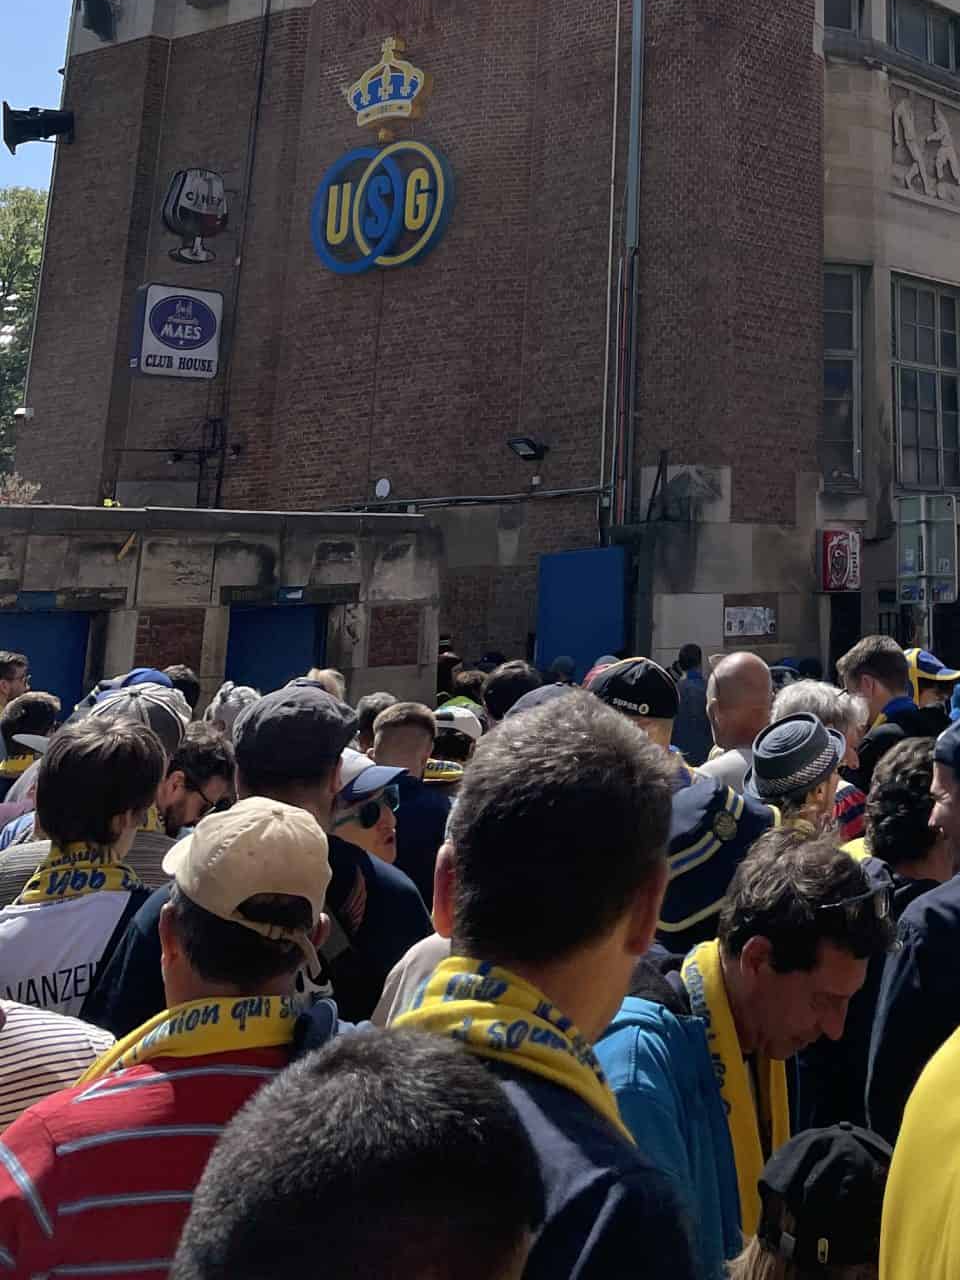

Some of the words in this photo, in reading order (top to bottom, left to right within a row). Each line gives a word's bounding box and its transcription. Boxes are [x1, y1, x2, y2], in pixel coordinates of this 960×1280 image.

[326, 167, 430, 246] USG
[160, 324, 202, 340] MAES
[145, 354, 173, 369] CLUB
[178, 356, 214, 372] HOUSE
